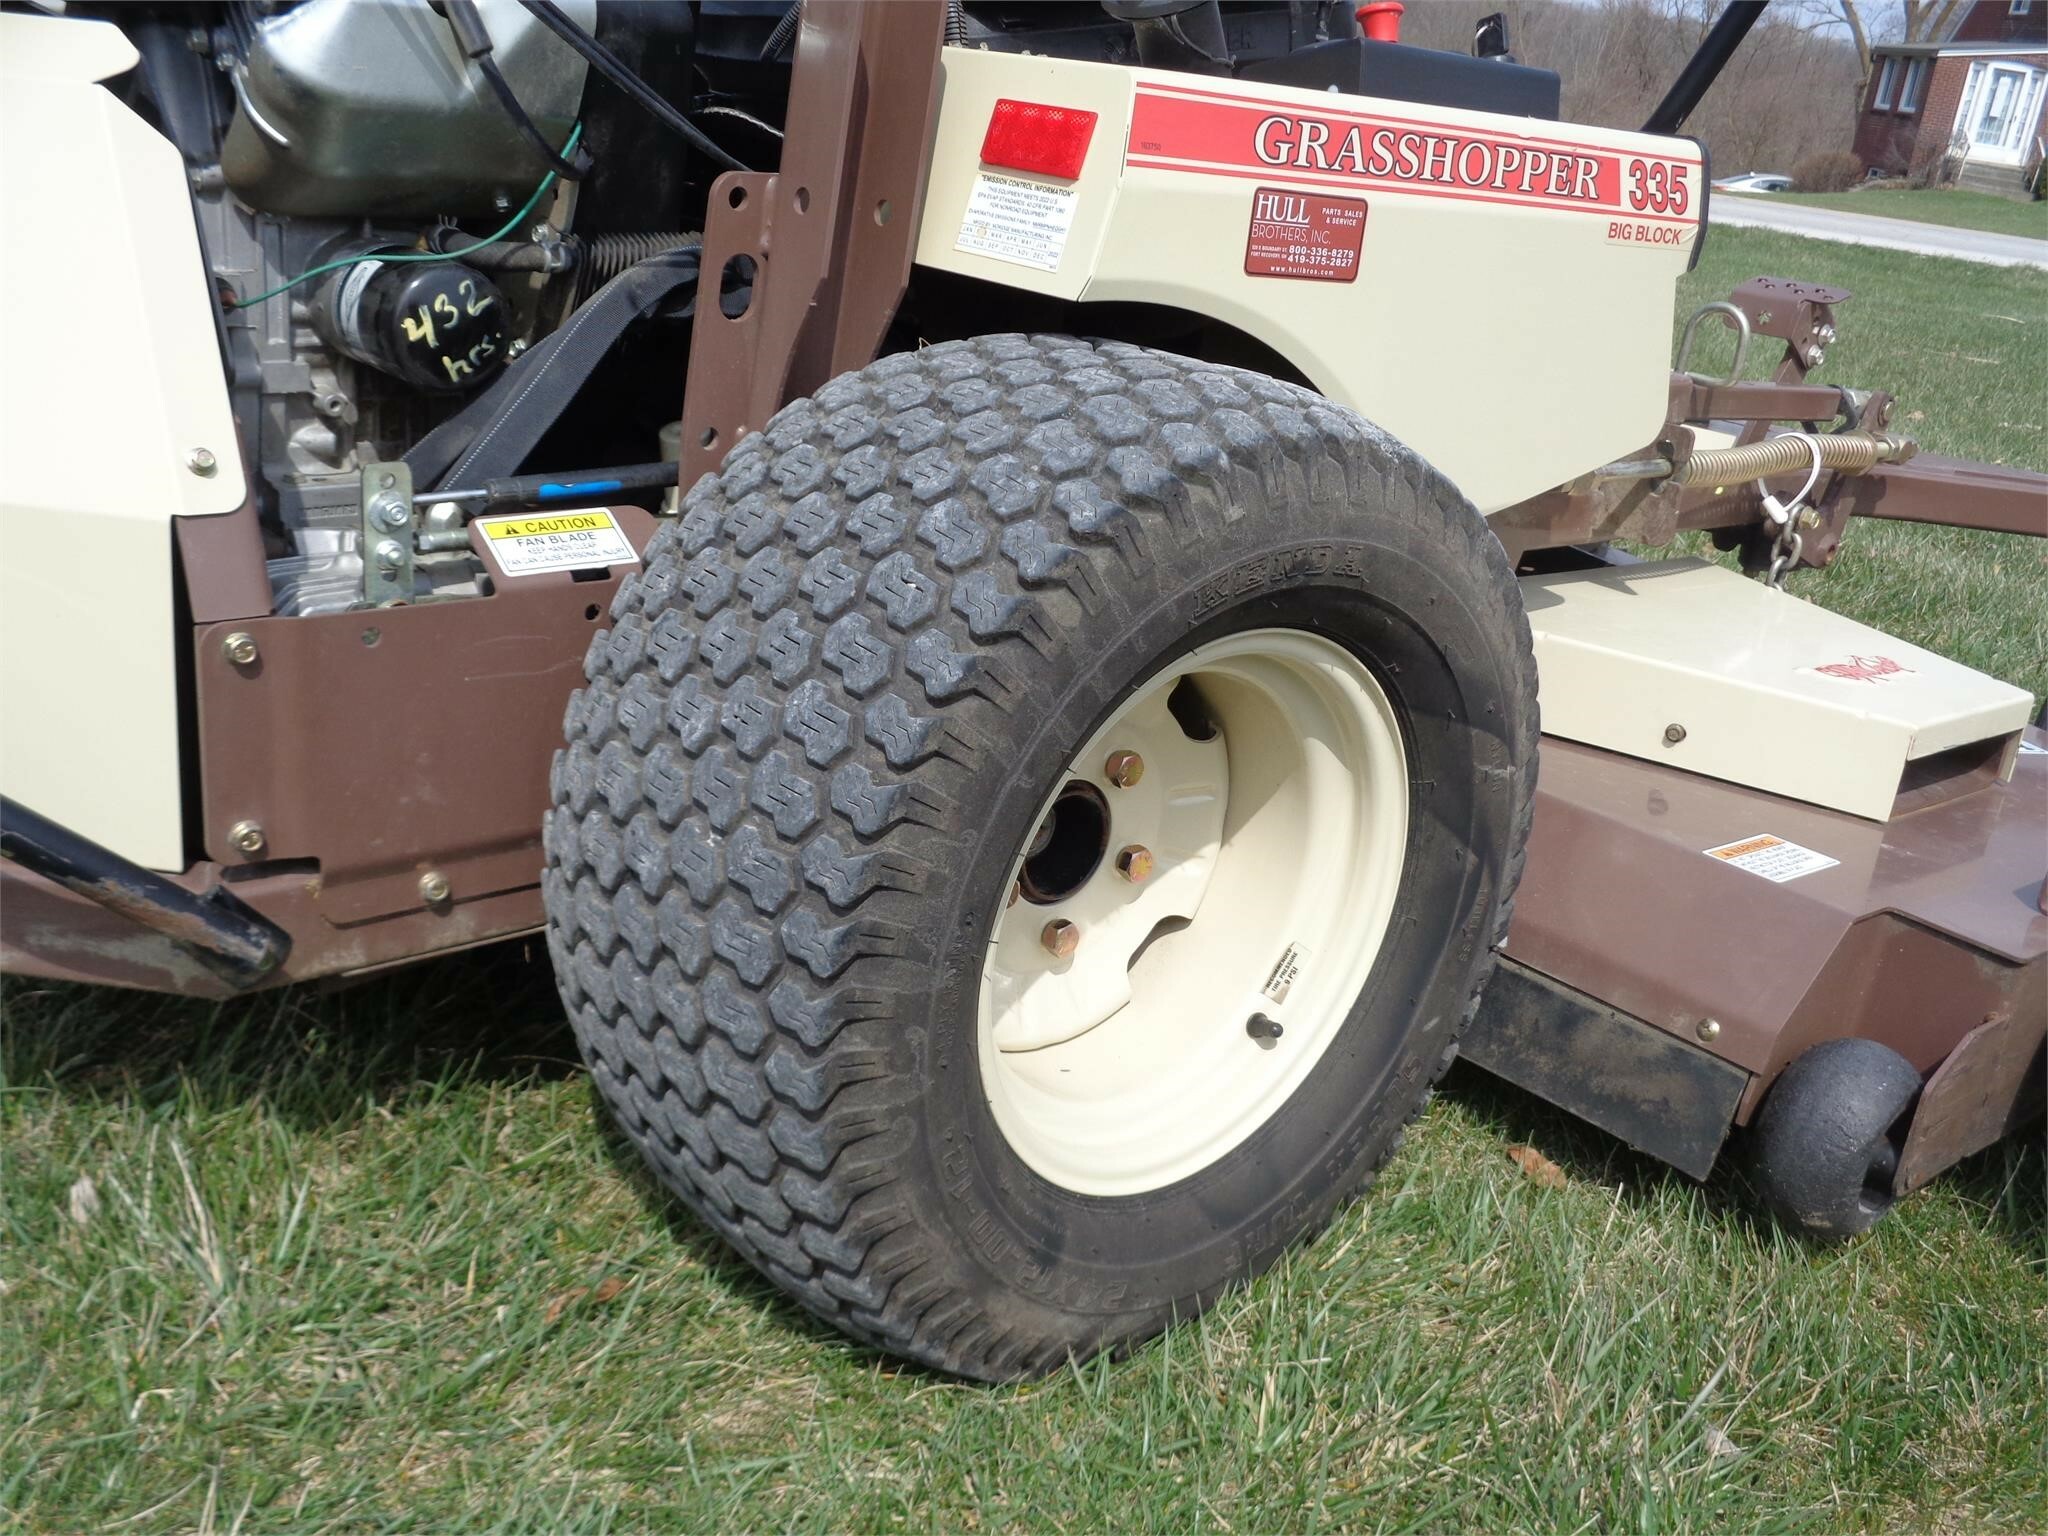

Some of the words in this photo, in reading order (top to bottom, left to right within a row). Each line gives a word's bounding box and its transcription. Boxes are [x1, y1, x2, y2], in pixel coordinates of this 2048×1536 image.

[1253, 115, 1600, 200] GRASSHOPPER
[1629, 159, 1688, 215] 335
[1008, 179, 1032, 191] CONTROL
[998, 187, 1023, 199] EQUIPMENT
[1021, 208, 1048, 218] EQUIPMENT
[1256, 194, 1310, 224] HULL
[1322, 208, 1341, 216] PARTS
[1344, 209, 1362, 218] SALES
[991, 230, 1002, 239] MAR
[1006, 233, 1017, 242] APR
[1036, 240, 1047, 249] JUN
[1251, 223, 1308, 244] BROTHERS,
[1311, 231, 1331, 245] INC.
[1607, 221, 1631, 241] BIG
[1634, 224, 1682, 246] BLOCK
[1002, 245, 1014, 253] OCT
[1018, 249, 1029, 257] NOV
[1032, 252, 1045, 260] DEC
[1289, 245, 1354, 258] 800-336-8279
[1288, 255, 1353, 267] 419-375-2827
[1271, 267, 1334, 276] www.hullbros.com
[400, 279, 494, 349] 432
[525, 517, 597, 533] CAUTION
[516, 536, 545, 547] FAN
[550, 532, 598, 544] BLADE
[564, 551, 600, 559] PERSONAL
[1191, 543, 1364, 620] KENDA
[1272, 980, 1281, 992] TIRE
[1280, 952, 1298, 979] PRESSURE
[1288, 966, 1298, 979] PSI
